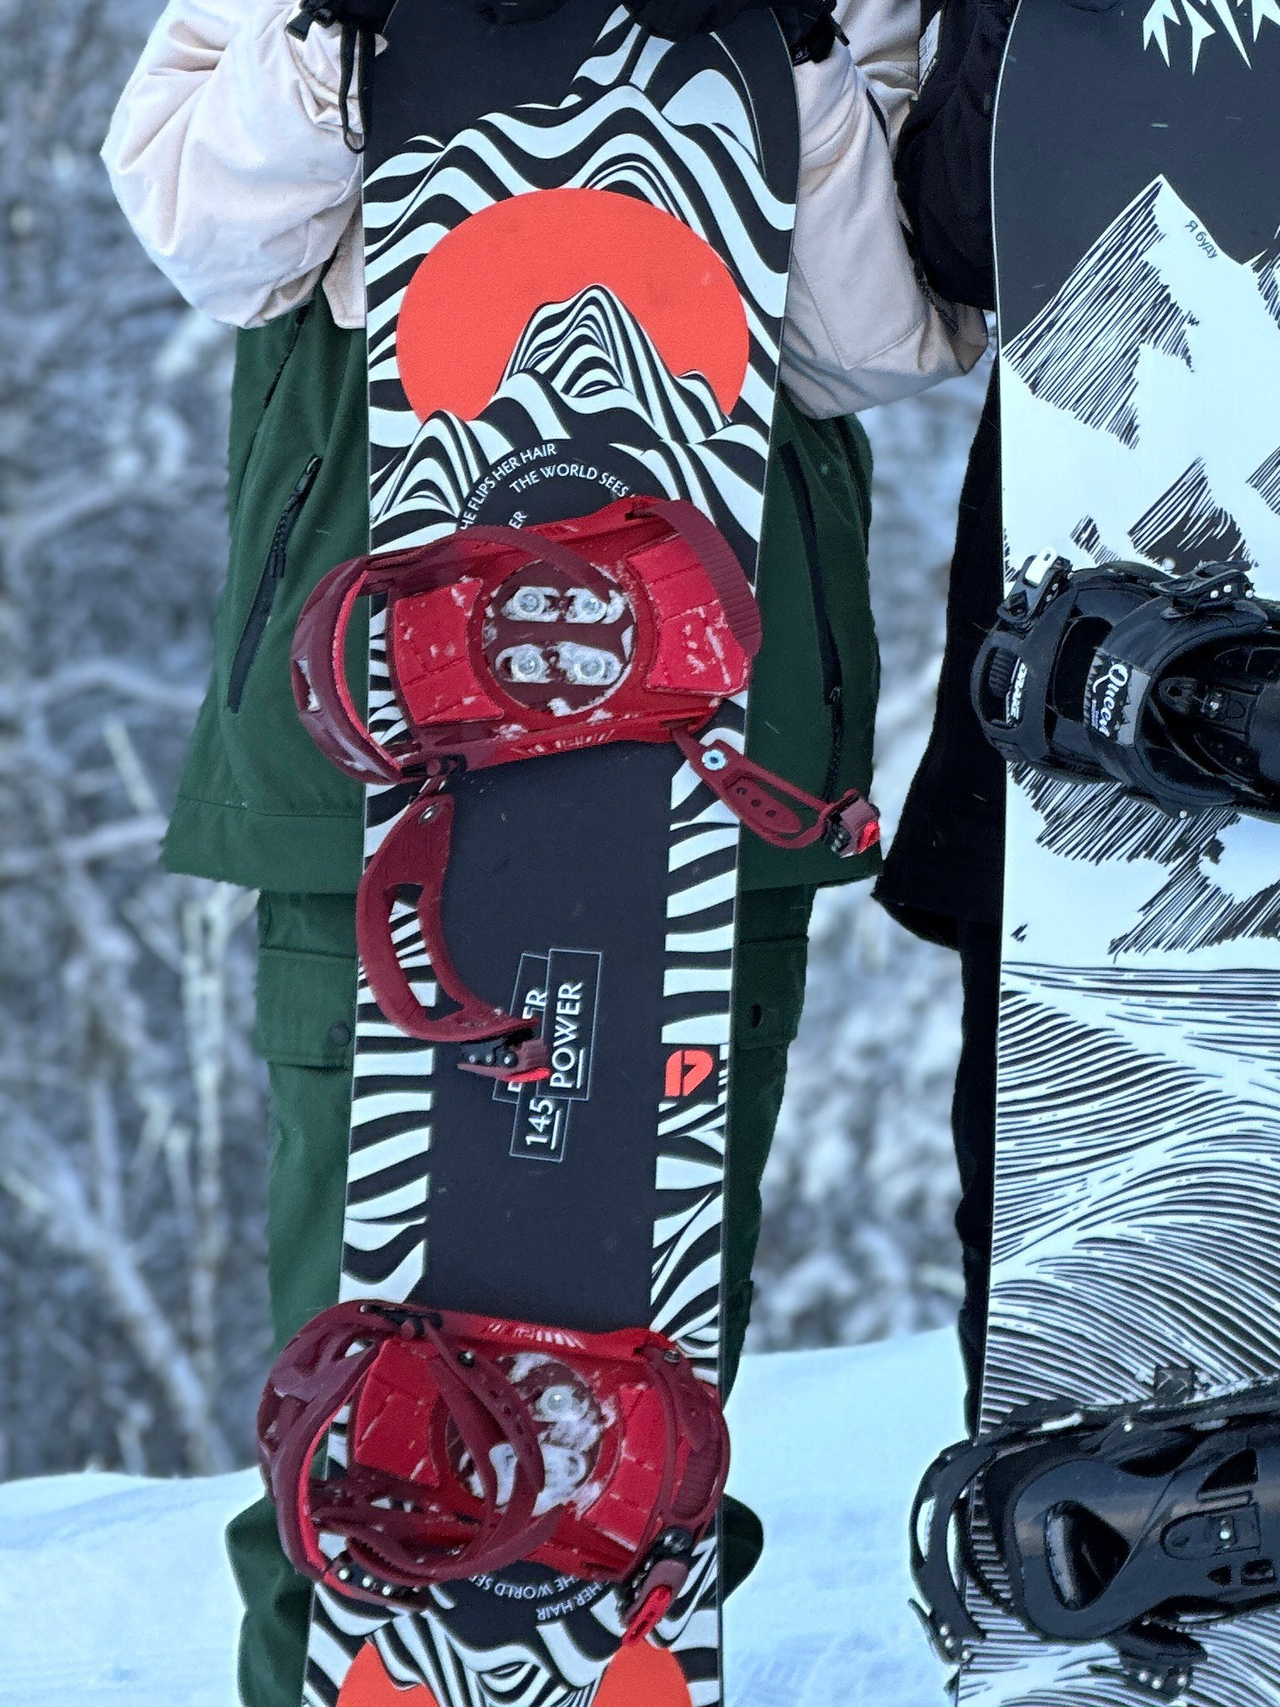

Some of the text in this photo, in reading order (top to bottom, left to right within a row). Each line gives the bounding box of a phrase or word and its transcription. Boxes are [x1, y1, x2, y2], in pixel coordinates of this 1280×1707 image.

[1184, 220, 1218, 259] Я буду
[459, 443, 557, 531] HE FLIPS HER HAIR
[509, 463, 630, 498] THE WORLD SEES
[1092, 663, 1129, 737] Queen
[550, 982, 584, 1089] POWER
[525, 1097, 554, 1146] 145
[468, 1574, 580, 1600] HE WORLD SE
[536, 1599, 574, 1621] HAIR
